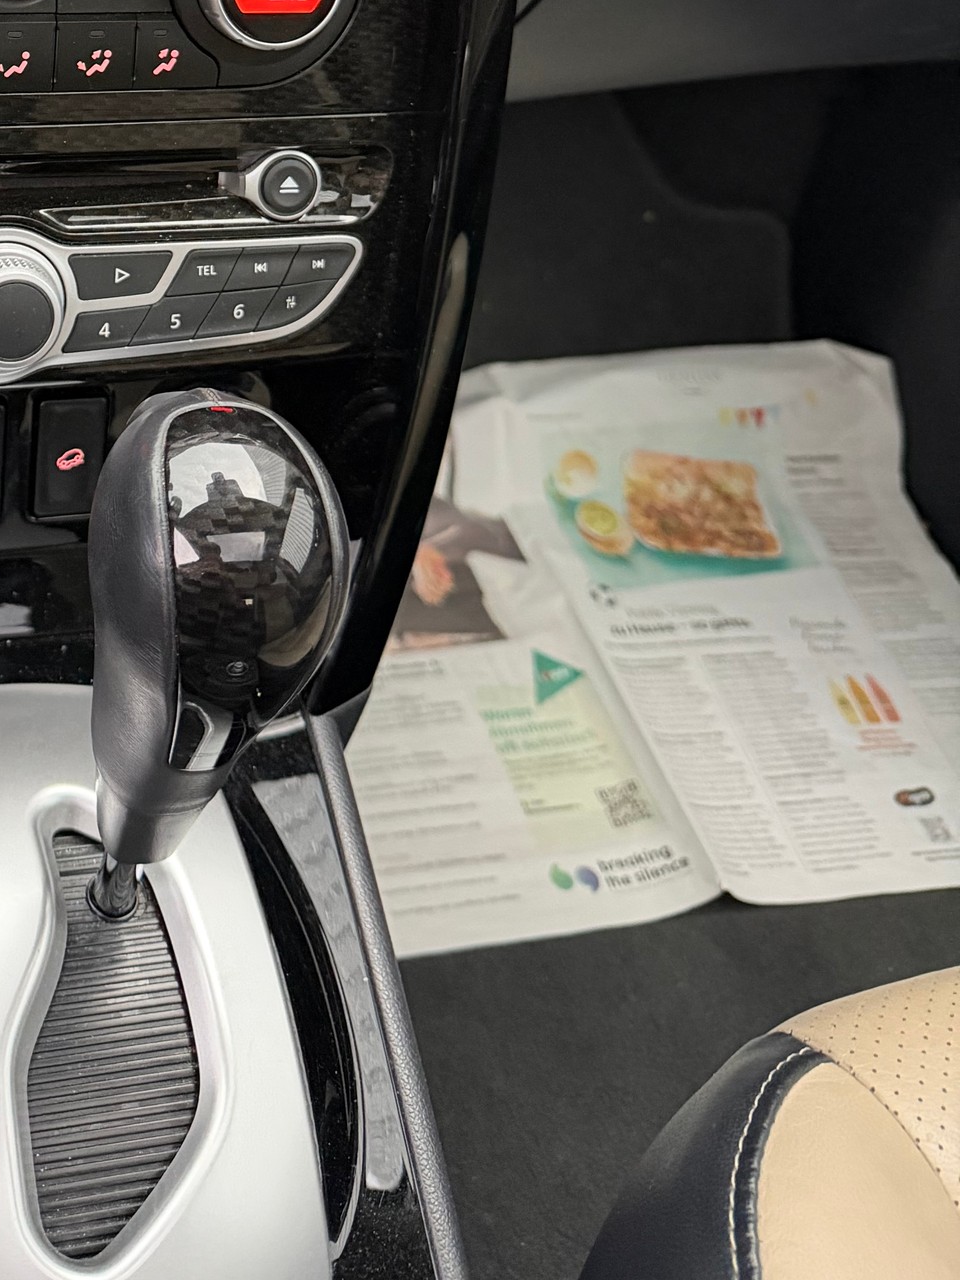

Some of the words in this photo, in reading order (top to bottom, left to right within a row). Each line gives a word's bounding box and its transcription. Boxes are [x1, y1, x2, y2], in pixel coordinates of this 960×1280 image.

[197, 264, 218, 277] TEL
[233, 303, 245, 319] 6
[169, 313, 182, 329] 5
[98, 322, 111, 338] 4
